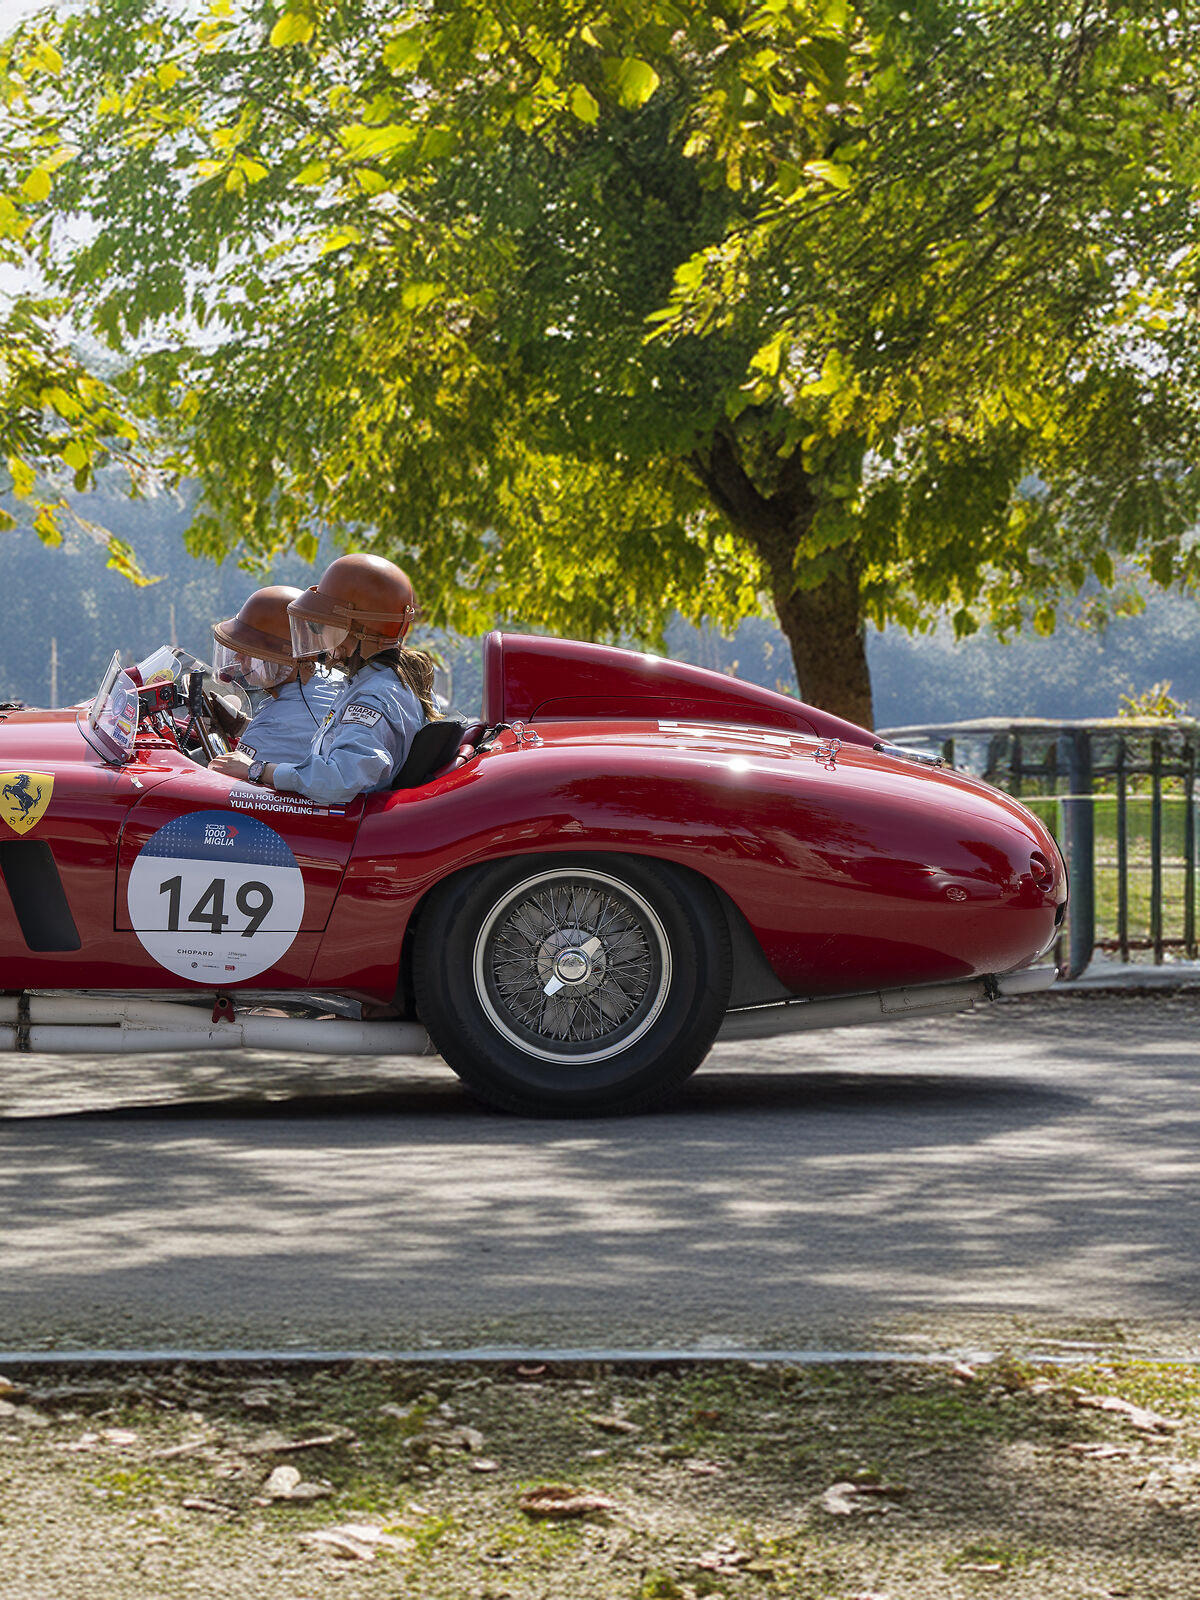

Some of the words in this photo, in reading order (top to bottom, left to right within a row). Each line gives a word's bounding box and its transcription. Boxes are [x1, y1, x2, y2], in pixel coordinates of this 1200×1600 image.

[348, 706, 377, 719] CHAPAL
[229, 791, 255, 800] ALISIA
[256, 794, 313, 806] HOUGHTALING
[230, 800, 254, 809] YULIA
[255, 803, 312, 815] HOUGHTALING
[205, 829, 226, 838] 1000
[203, 837, 234, 846] MIGLIA
[160, 875, 273, 937] 149
[177, 948, 214, 957] CHOPARD
